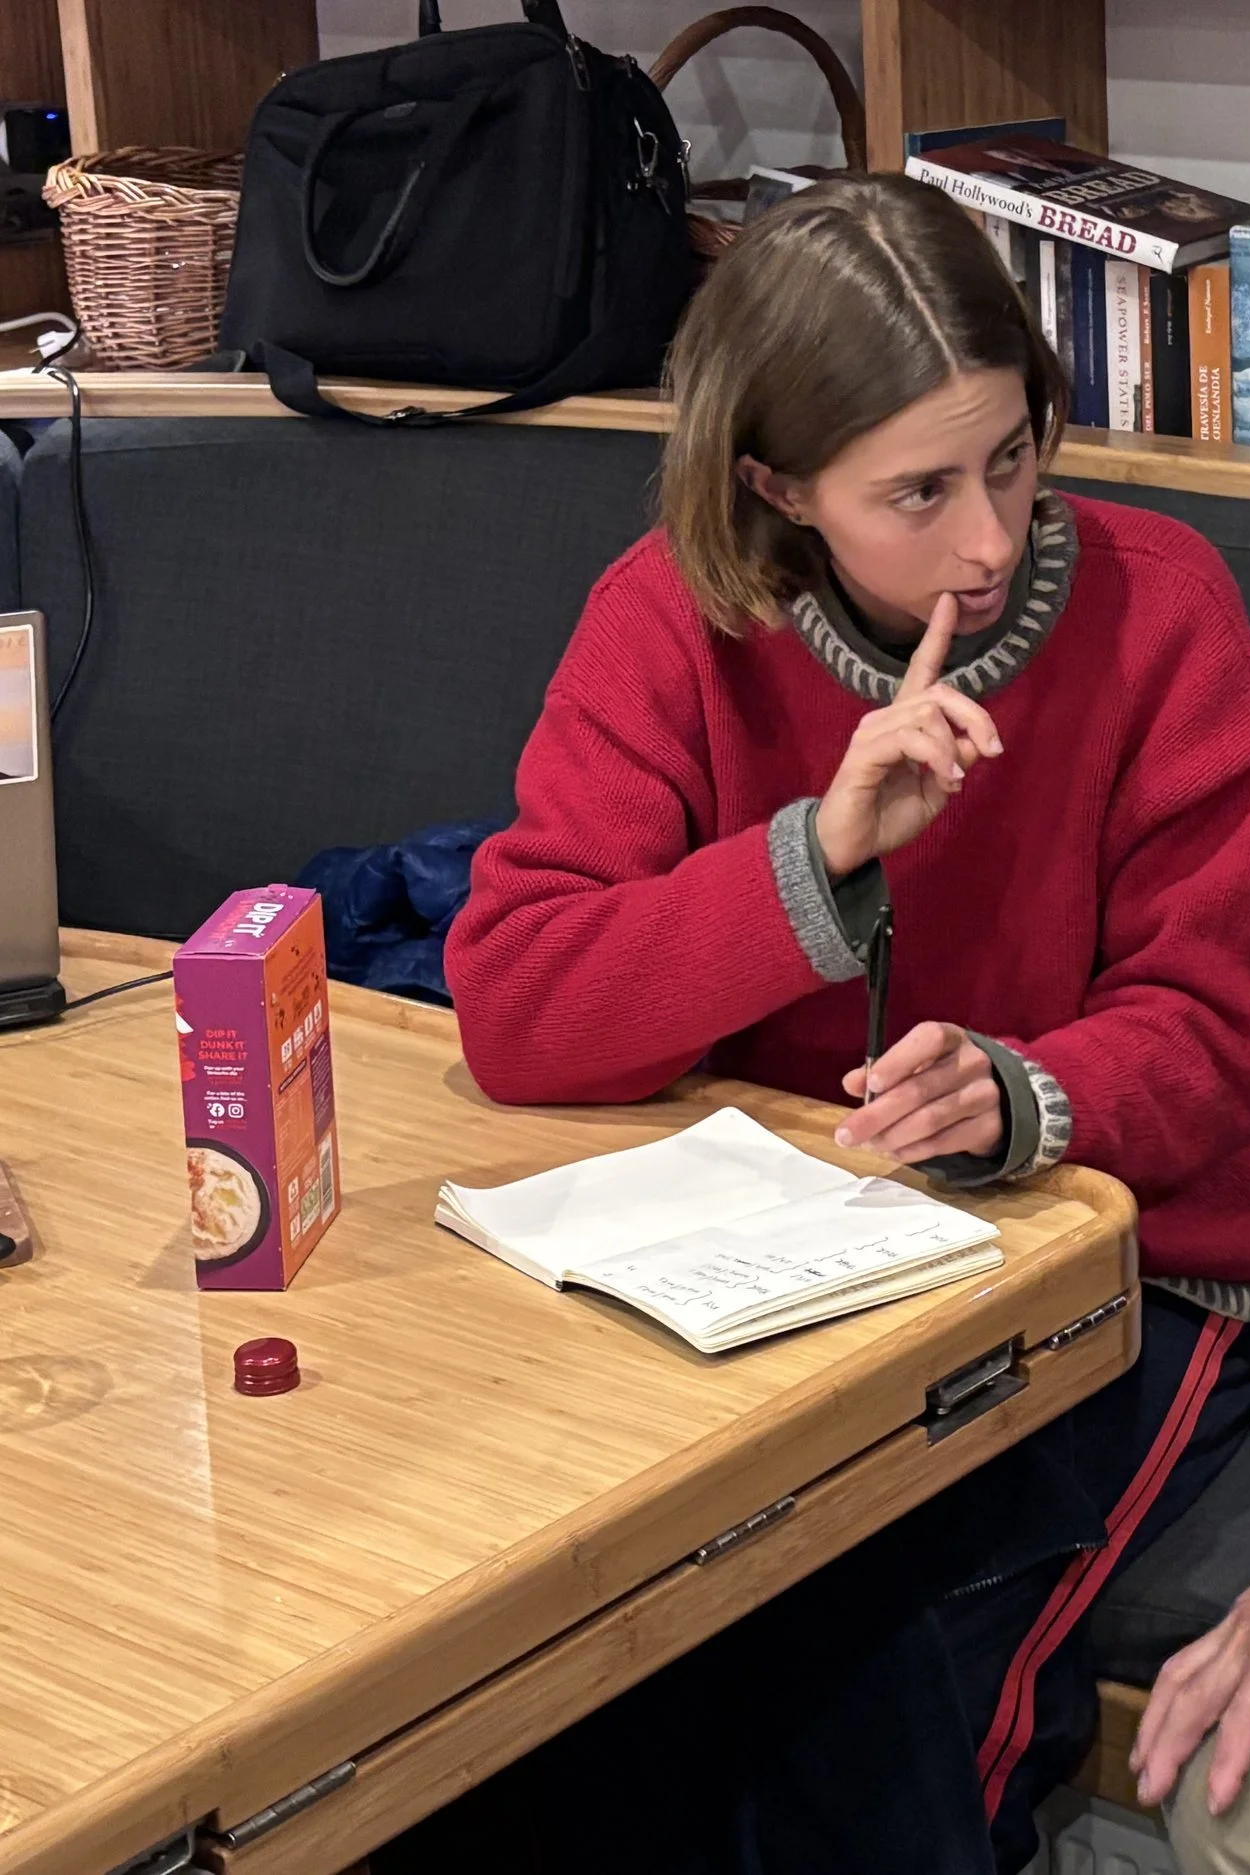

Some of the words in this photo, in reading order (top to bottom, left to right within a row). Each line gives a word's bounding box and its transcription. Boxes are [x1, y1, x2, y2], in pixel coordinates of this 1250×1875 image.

[1046, 171, 1162, 206] BREAD
[919, 167, 949, 193] Paul
[950, 178, 1034, 220] Hollywood's
[1036, 203, 1138, 256] BREAD
[1115, 274, 1130, 365] SEAPOWER
[1144, 361, 1152, 381] SUR
[1199, 365, 1209, 384] DE
[1117, 366, 1131, 429] STATES
[245, 901, 284, 926] DIP
[232, 921, 264, 938] IT
[205, 1029, 225, 1038] DIP
[226, 1029, 237, 1039] IT
[200, 1040, 233, 1050] DUNK
[234, 1040, 245, 1050] IT
[197, 1050, 236, 1060] SHARE
[238, 1050, 248, 1061] IT
